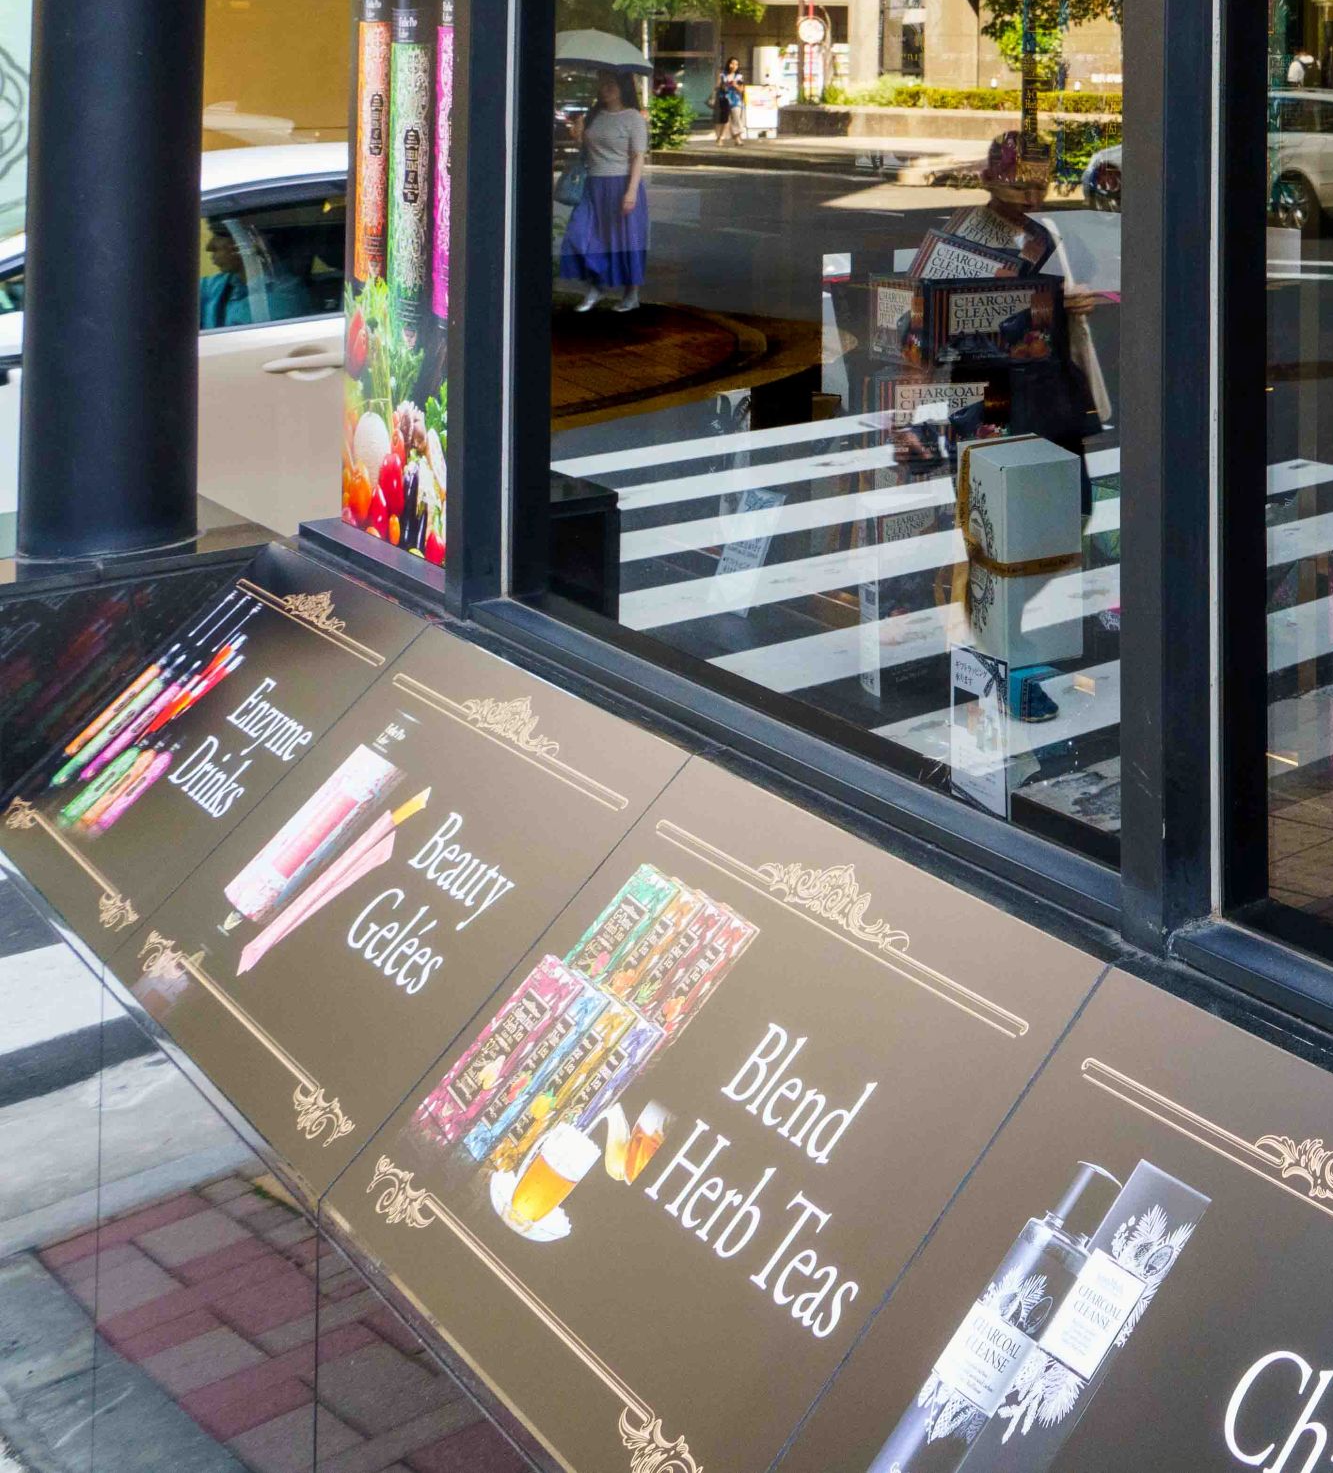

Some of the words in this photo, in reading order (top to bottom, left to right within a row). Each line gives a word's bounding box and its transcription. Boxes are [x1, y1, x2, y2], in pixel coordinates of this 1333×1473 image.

[936, 247, 997, 275] CHARCOAL
[953, 293, 1032, 309] CHARCOAL
[953, 305, 1018, 320] CLEANSE
[954, 319, 995, 332] JELLY
[900, 385, 984, 399] CHARCOAL
[227, 677, 313, 762] Enzyme
[167, 735, 246, 819] Drinks
[407, 812, 517, 931] Beauty
[347, 887, 444, 995] Gelées
[720, 1022, 879, 1165] Blend
[644, 1118, 777, 1260] Herb
[748, 1190, 860, 1339] Teas
[1077, 1285, 1122, 1321] CHARCOAL
[965, 1335, 1010, 1374] CLEANSE
[972, 1316, 1022, 1360] CHARCOAL
